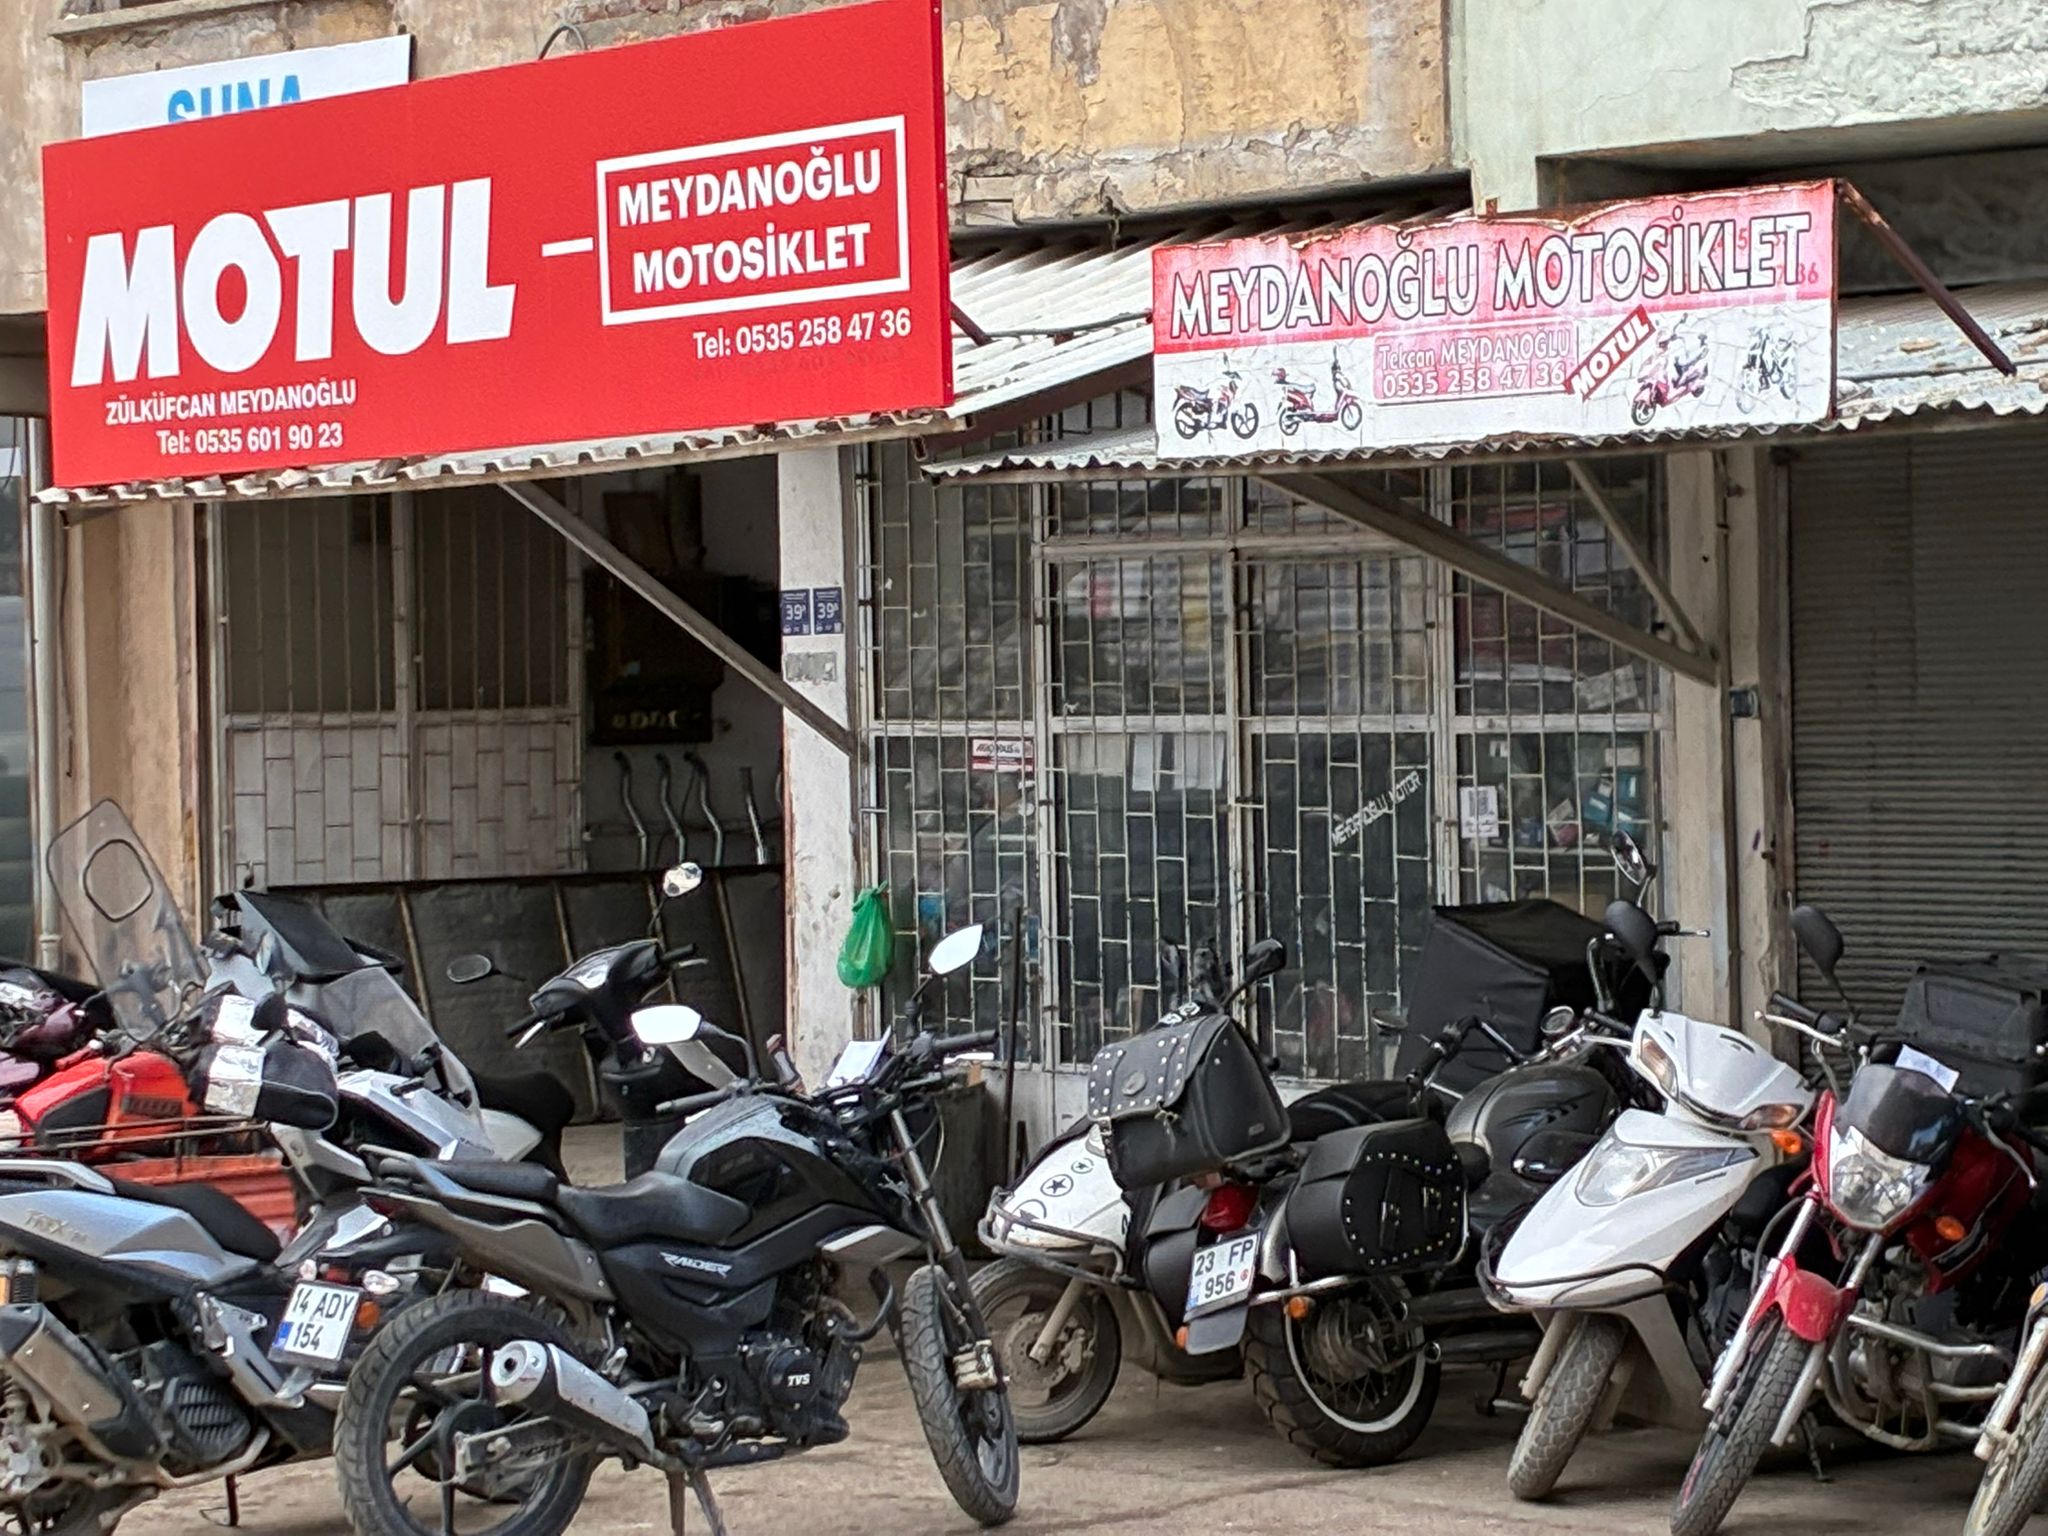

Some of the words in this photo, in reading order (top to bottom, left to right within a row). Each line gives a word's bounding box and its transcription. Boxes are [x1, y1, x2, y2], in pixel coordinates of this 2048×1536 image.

[618, 147, 881, 227] MEYDANOĞLU
[633, 222, 871, 293] MOTOSİKLET
[1170, 231, 1480, 339] MEYDANOĞLU
[1493, 206, 1811, 311] MOTOSİKLET
[71, 177, 517, 388] MOTUL
[693, 328, 731, 359] Tel:
[736, 321, 795, 354] 0535
[799, 316, 842, 348] 258
[847, 311, 875, 341] 47
[880, 308, 911, 338] 36
[1440, 327, 1571, 366] MEYDANOĞLU
[1383, 371, 1439, 397] 0535
[1447, 366, 1492, 393] 258
[1500, 363, 1528, 389] 47
[1535, 361, 1567, 387] 36
[1569, 314, 1650, 401] MOTUL
[106, 391, 215, 425] ZÜLKÜFCAN
[221, 378, 357, 415] MEYDANOĞLU
[156, 430, 191, 455] Tel:
[195, 428, 242, 453] 0535
[247, 426, 281, 452] 601
[288, 424, 313, 449] 90
[318, 422, 343, 447] 23
[1194, 1250, 1215, 1278] 23
[1228, 1239, 1254, 1267] FP
[292, 1287, 313, 1313] 14
[309, 1291, 355, 1322] ADY
[1204, 1270, 1235, 1299] 956
[293, 1321, 324, 1351] 154
